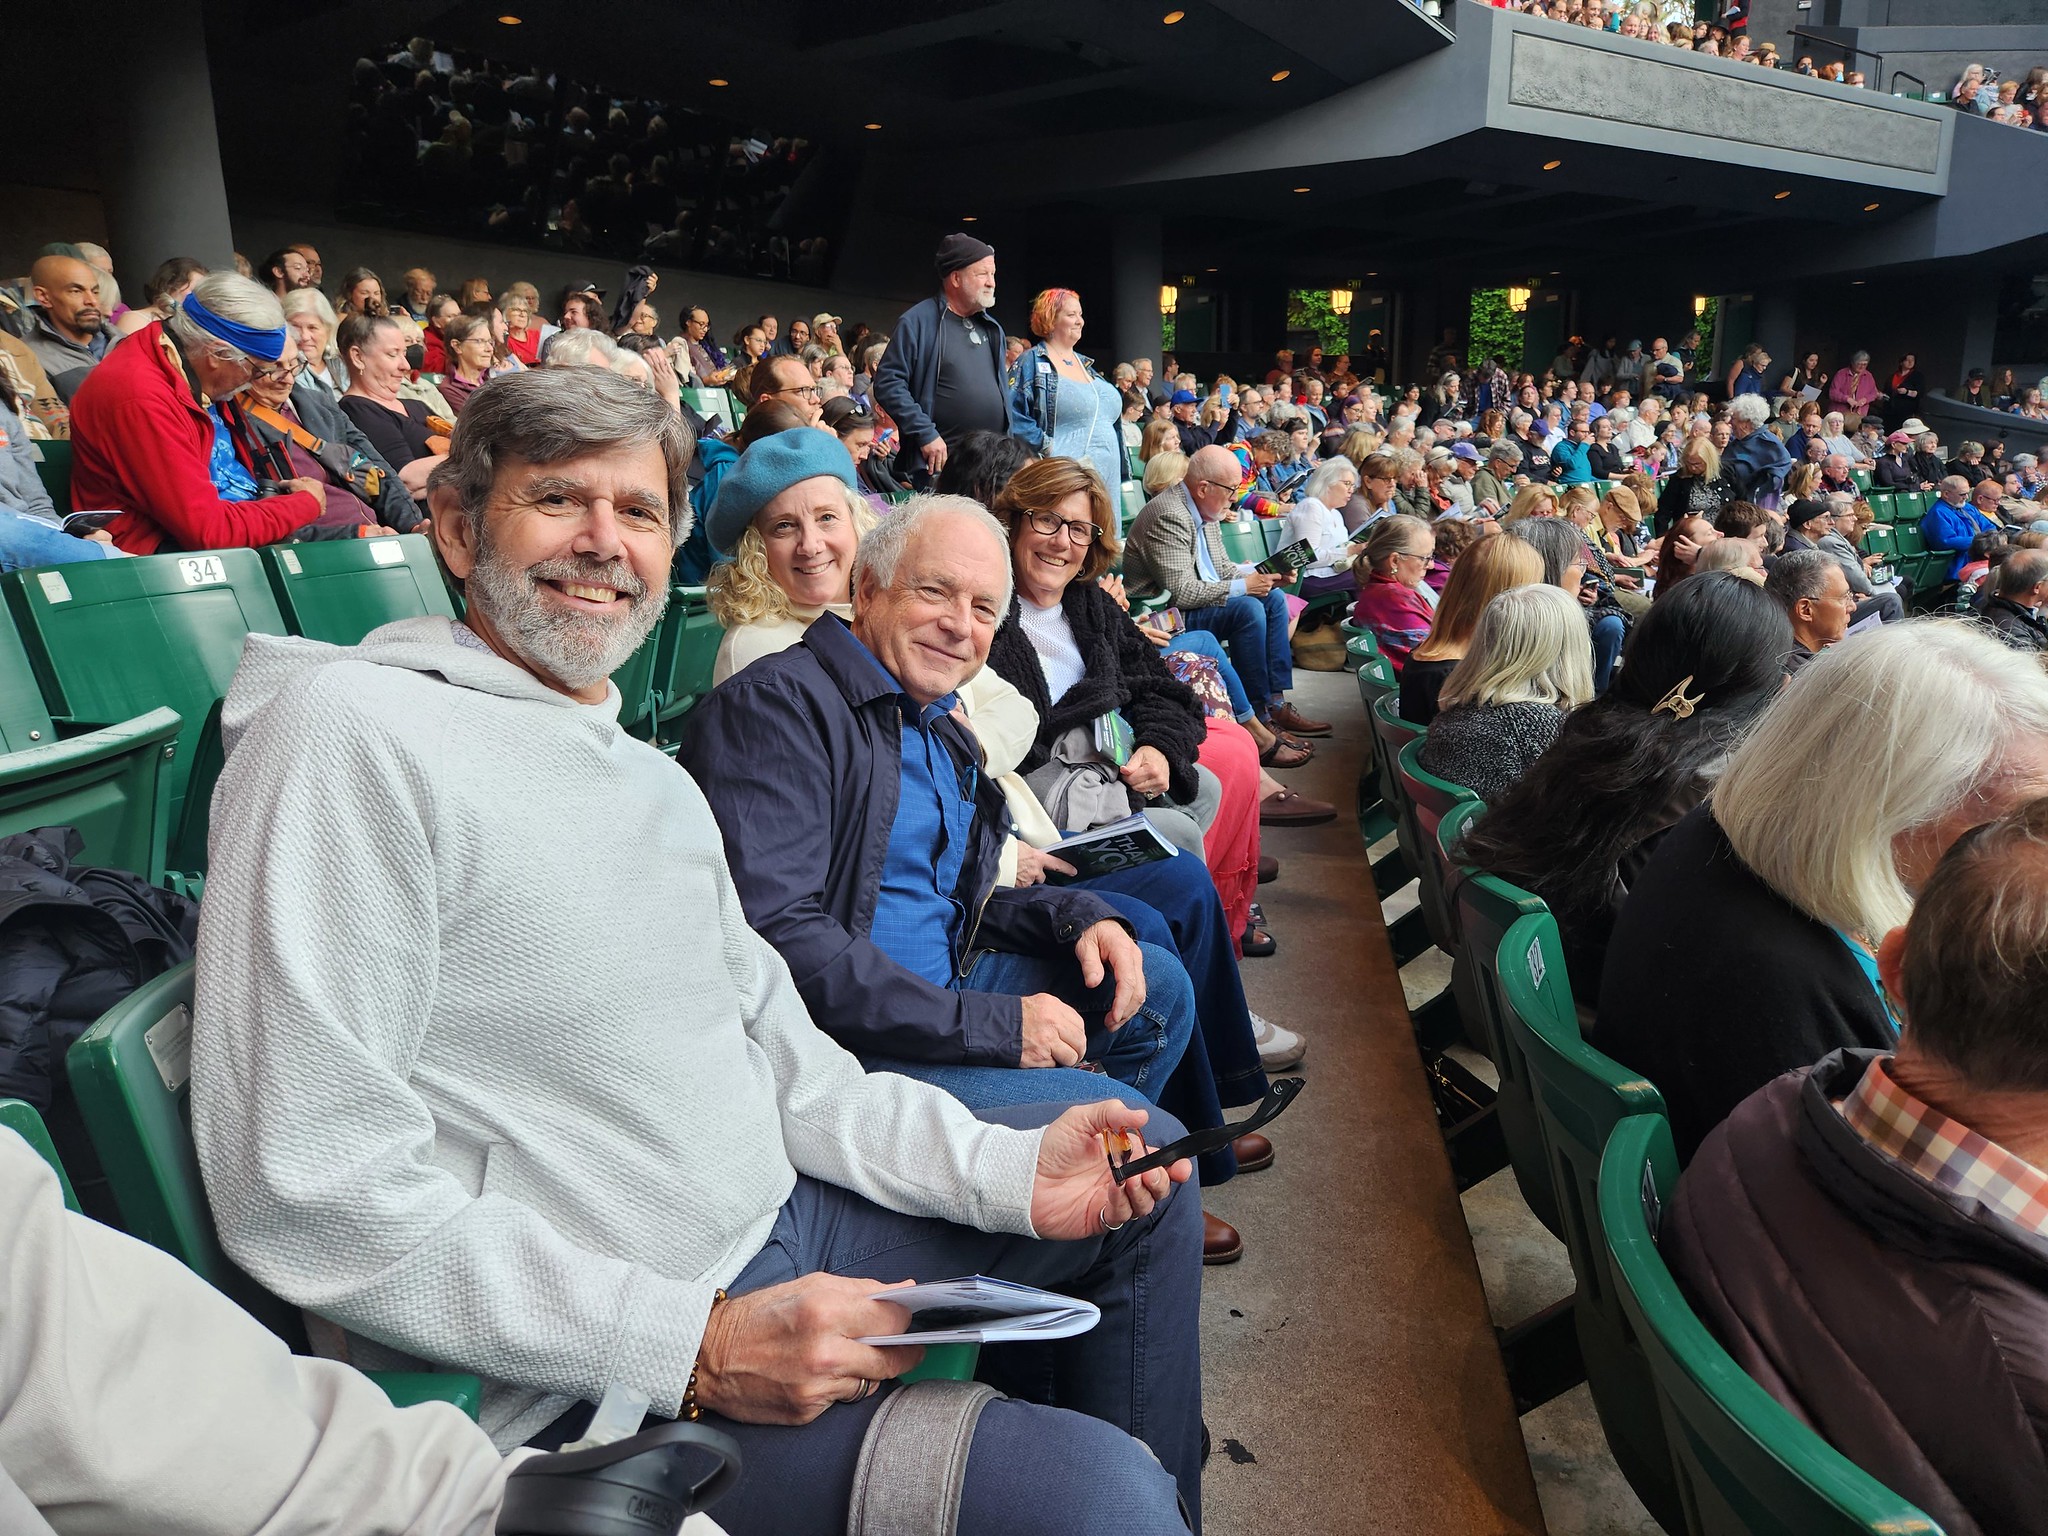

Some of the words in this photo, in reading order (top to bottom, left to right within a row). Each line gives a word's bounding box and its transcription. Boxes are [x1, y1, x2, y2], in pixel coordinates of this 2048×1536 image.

[1284, 545, 1303, 569] YOU
[1293, 542, 1310, 565] THANK
[189, 559, 217, 583] 34
